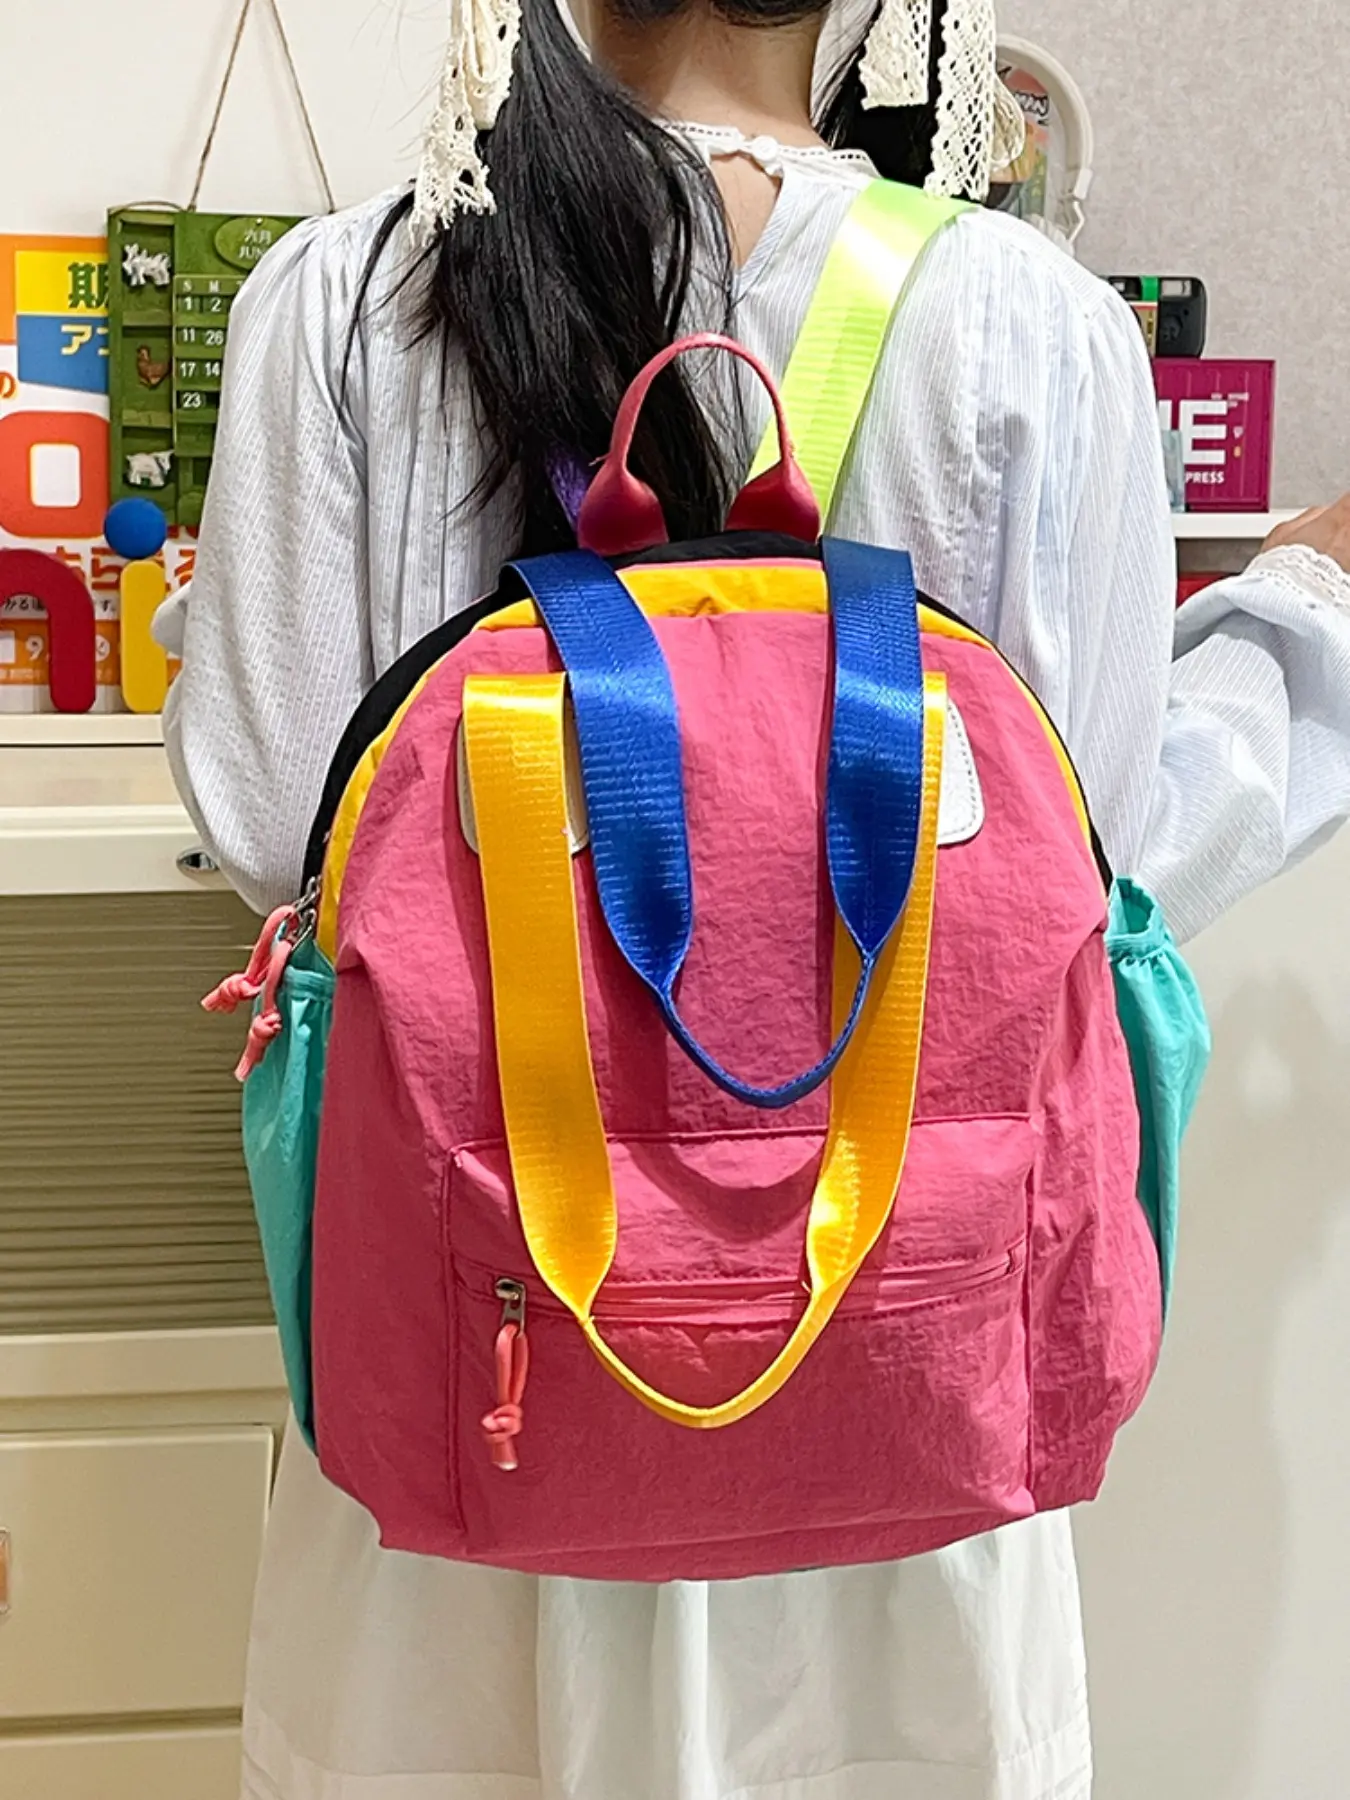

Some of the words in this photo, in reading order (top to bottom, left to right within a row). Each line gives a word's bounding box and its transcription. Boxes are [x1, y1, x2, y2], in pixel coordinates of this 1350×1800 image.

[184, 296, 193, 311] 1
[211, 298, 222, 312] 2
[182, 327, 196, 342] 11
[180, 361, 197, 377] 17
[205, 361, 221, 377] 14
[183, 391, 202, 408] 23
